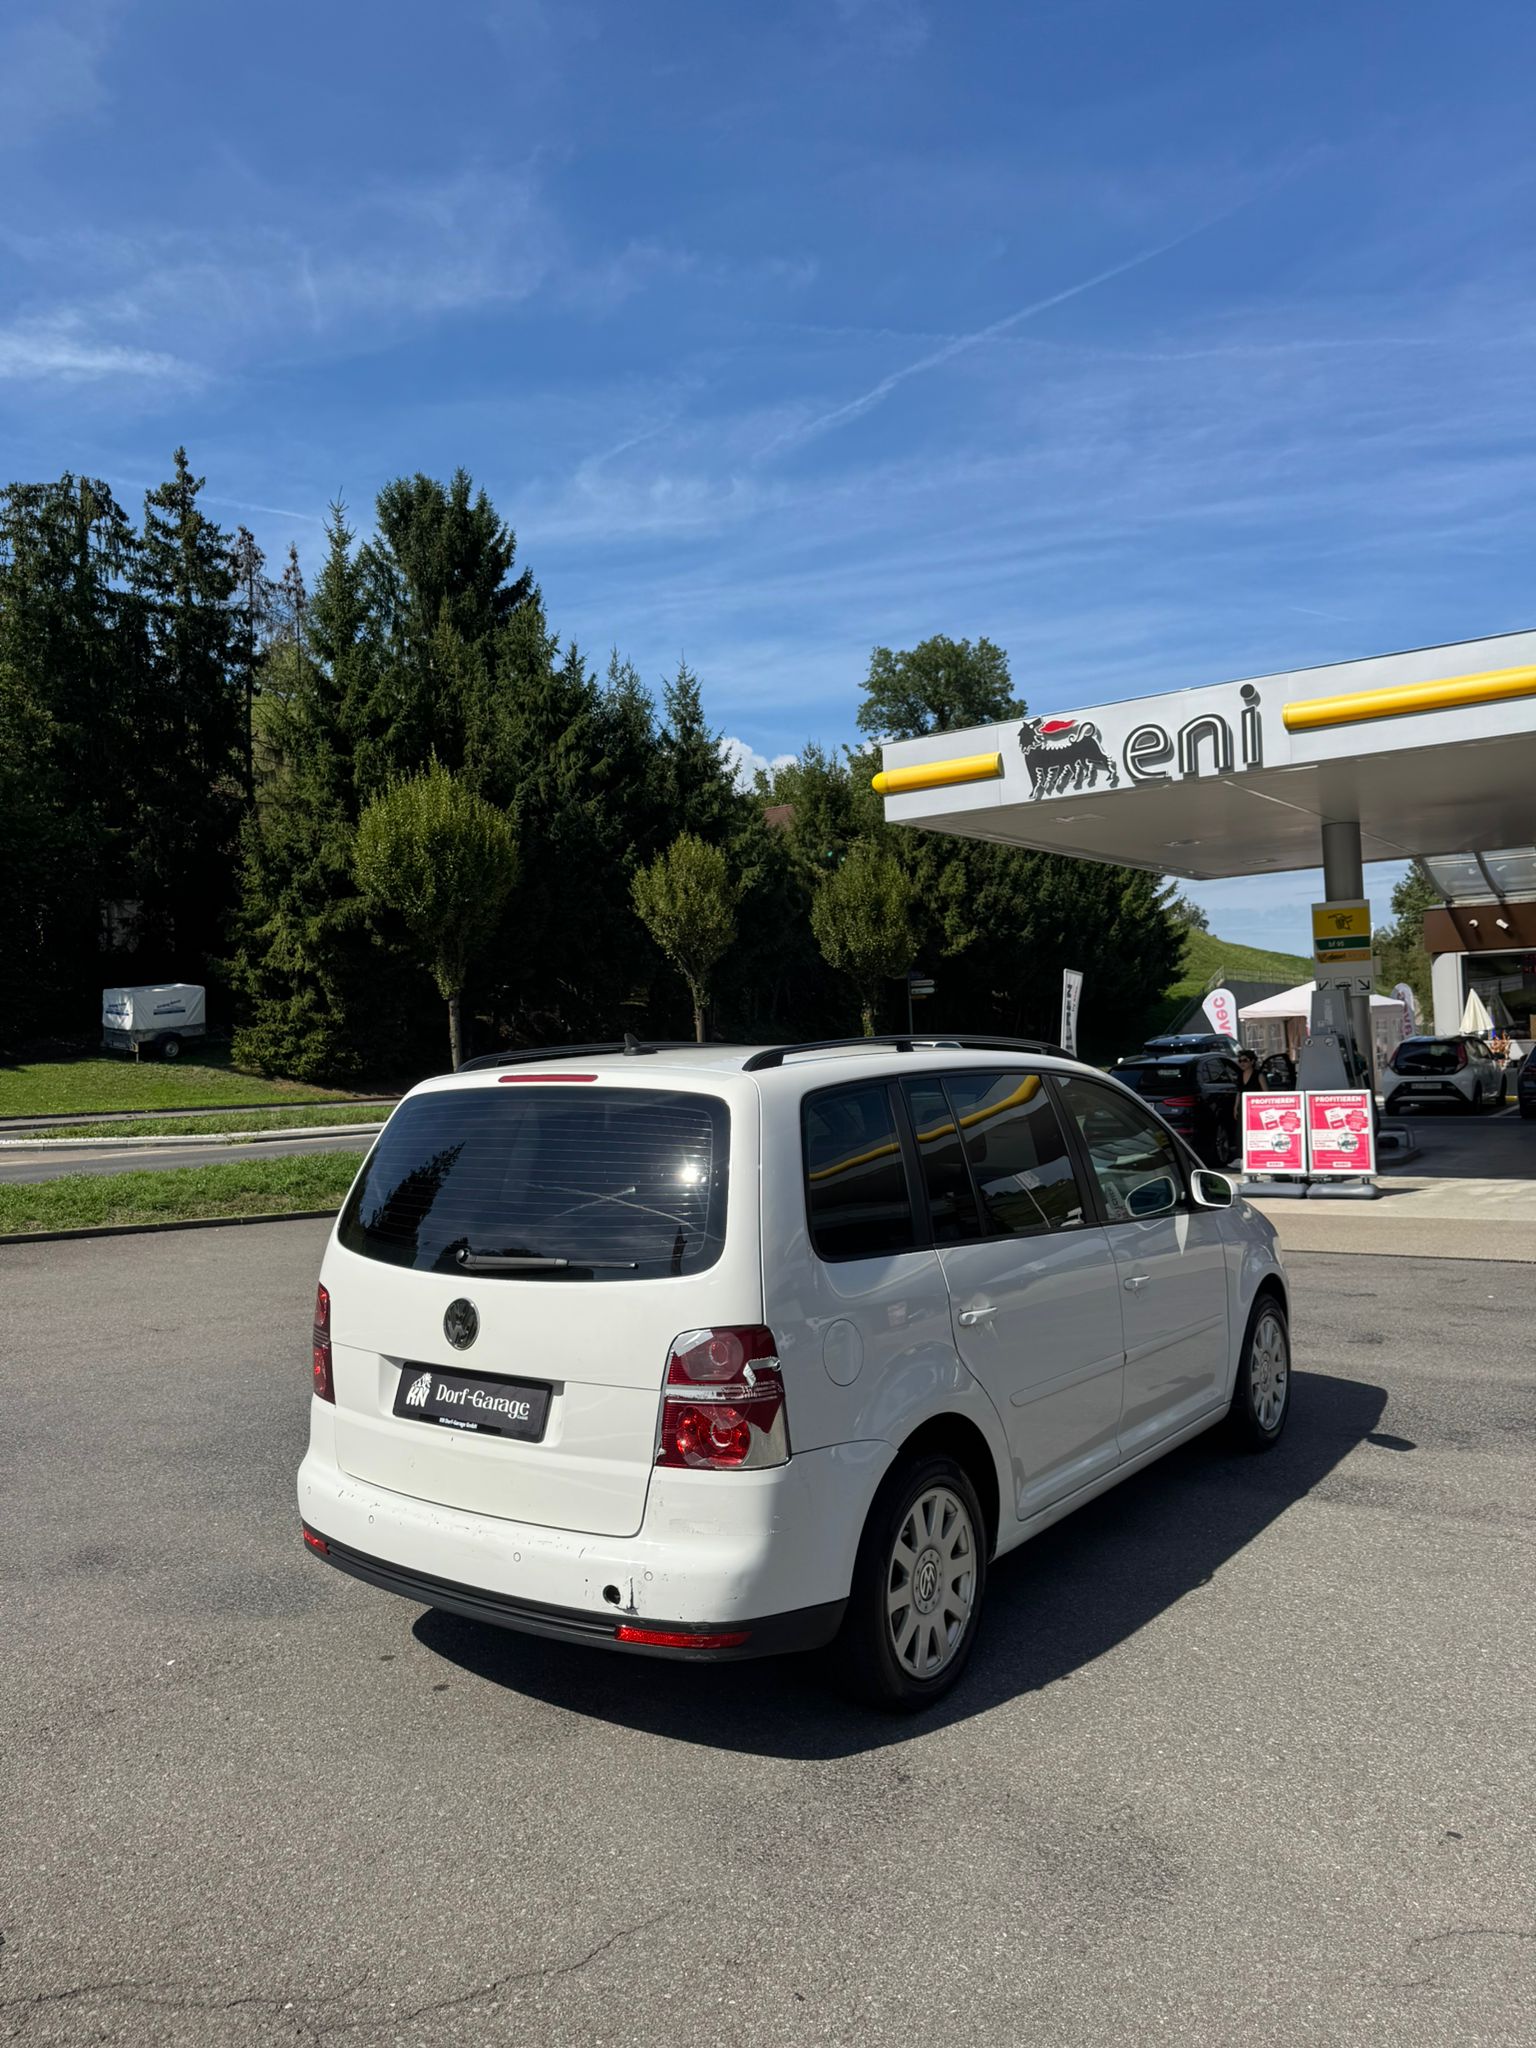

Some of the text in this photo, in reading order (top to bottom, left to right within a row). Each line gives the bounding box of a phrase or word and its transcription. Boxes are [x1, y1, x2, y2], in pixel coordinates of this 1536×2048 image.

[1123, 684, 1259, 780] eni
[1251, 1097, 1296, 1105] PROFITIEREN
[436, 1384, 530, 1419] Dorf-Garage
